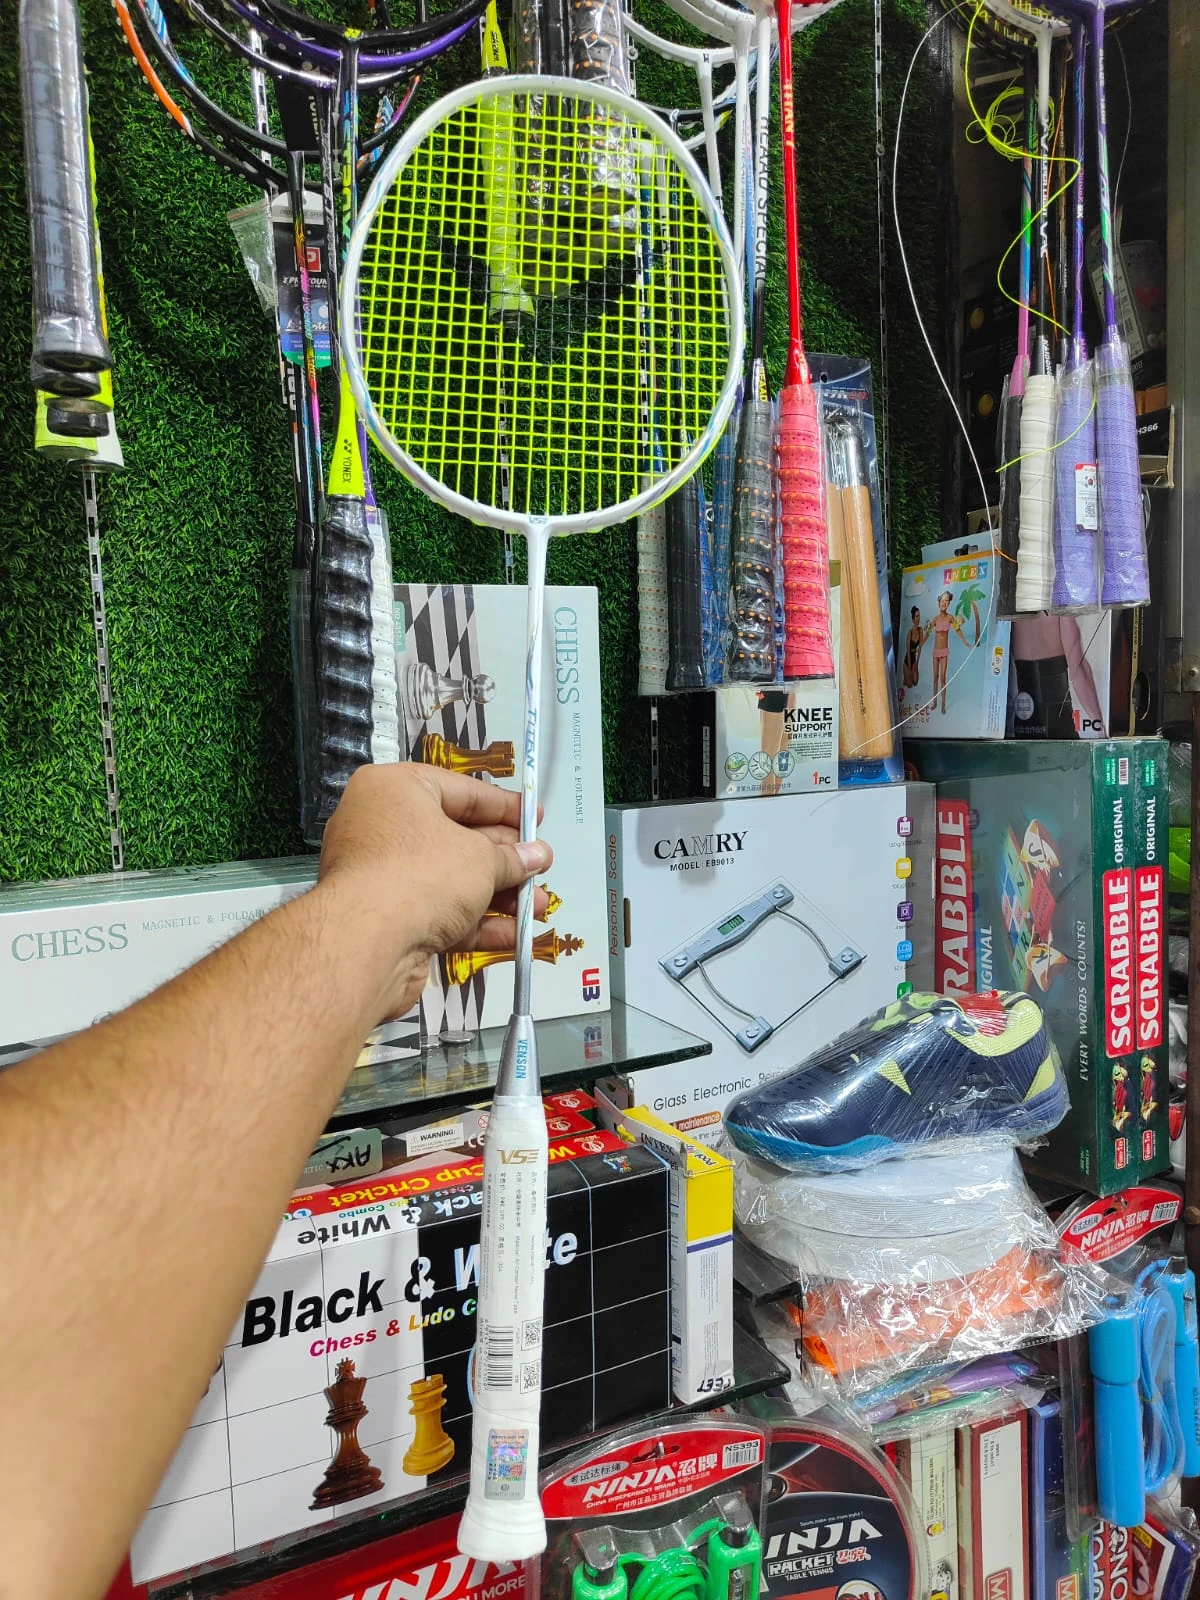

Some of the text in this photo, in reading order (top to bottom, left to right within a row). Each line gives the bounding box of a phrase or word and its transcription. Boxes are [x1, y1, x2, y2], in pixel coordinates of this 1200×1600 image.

[755, 199, 768, 288] SPECIAL
[342, 457, 352, 483] YONEX
[943, 562, 989, 585] INTEX
[554, 606, 581, 705] CHESS
[784, 707, 833, 723] KNEE
[784, 722, 833, 733] SUPPORT
[525, 708, 537, 769] TITAN
[571, 712, 582, 761] MAGNETIC
[812, 771, 832, 785] 1PC
[575, 777, 583, 825] FOLDABLE
[653, 830, 750, 860] CAMRY
[1113, 796, 1124, 863] ORIGINAL
[1146, 796, 1156, 861] ORIGINAL
[705, 857, 735, 868] EB9013
[609, 834, 619, 956] Personal Scale
[938, 811, 969, 996] RABBLE
[142, 915, 201, 933] MAGNETIC
[206, 915, 215, 924] &
[10, 922, 130, 962] CHESS
[1139, 873, 1159, 1041] SCRABBLE
[1108, 875, 1131, 1049] SCRABBLE
[1077, 919, 1089, 1082] EVERY WORDS COUNTS!
[515, 1039, 529, 1079] VENSON
[653, 1094, 687, 1111] Glass
[693, 1077, 752, 1101] Electronic
[419, 1128, 457, 1142] WARNING:
[678, 1112, 721, 1132] maintenance
[496, 1149, 541, 1165] VSE
[640, 1132, 674, 1156] INTEX
[328, 1163, 484, 1207] Cup Cricket
[434, 1184, 475, 1198] Chess
[297, 1191, 485, 1245] ack & White
[338, 1204, 385, 1219] Combo
[1081, 1218, 1126, 1250] NINJA
[242, 1270, 385, 1348] Black
[404, 1256, 437, 1303] &
[309, 1305, 456, 1357] Chess & Ludo
[677, 1453, 718, 1478] 忍牌
[582, 1464, 677, 1504] NINJA
[586, 1481, 677, 1510] CHINA INDEPENDENT BRAND
[764, 1518, 884, 1560] INJA
[769, 1553, 834, 1576] RACKET
[785, 1567, 834, 1581] TABLE TENNIS
[480, 1574, 527, 1600] MORE
